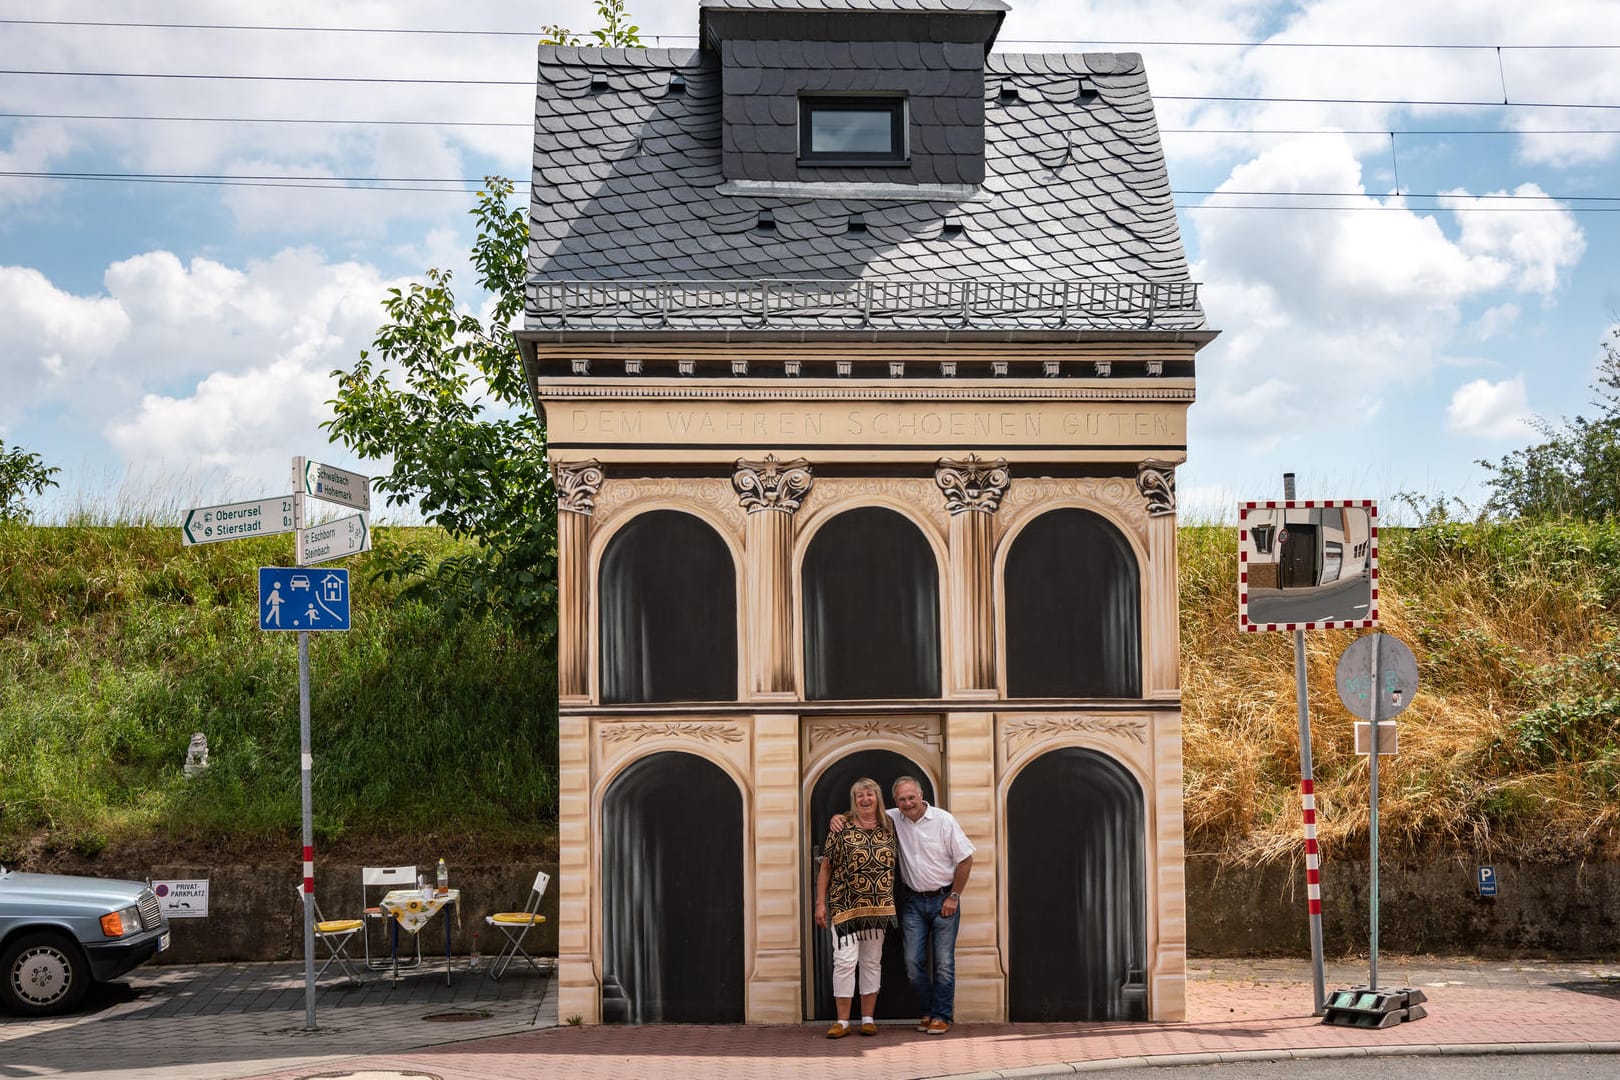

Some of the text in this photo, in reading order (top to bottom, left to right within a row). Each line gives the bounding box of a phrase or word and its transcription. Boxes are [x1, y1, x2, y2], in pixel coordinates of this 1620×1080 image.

[572, 410, 1175, 437] DEM WAHREN SCHOENEN GUTEN.
[317, 468, 348, 485] Schwalbach
[324, 484, 352, 501] Hohemark
[216, 505, 261, 521] Oberursel
[216, 521, 261, 535] Stierstadt
[311, 529, 335, 543] Eschborn
[305, 544, 330, 559] Steinbach
[1481, 868, 1491, 881] P
